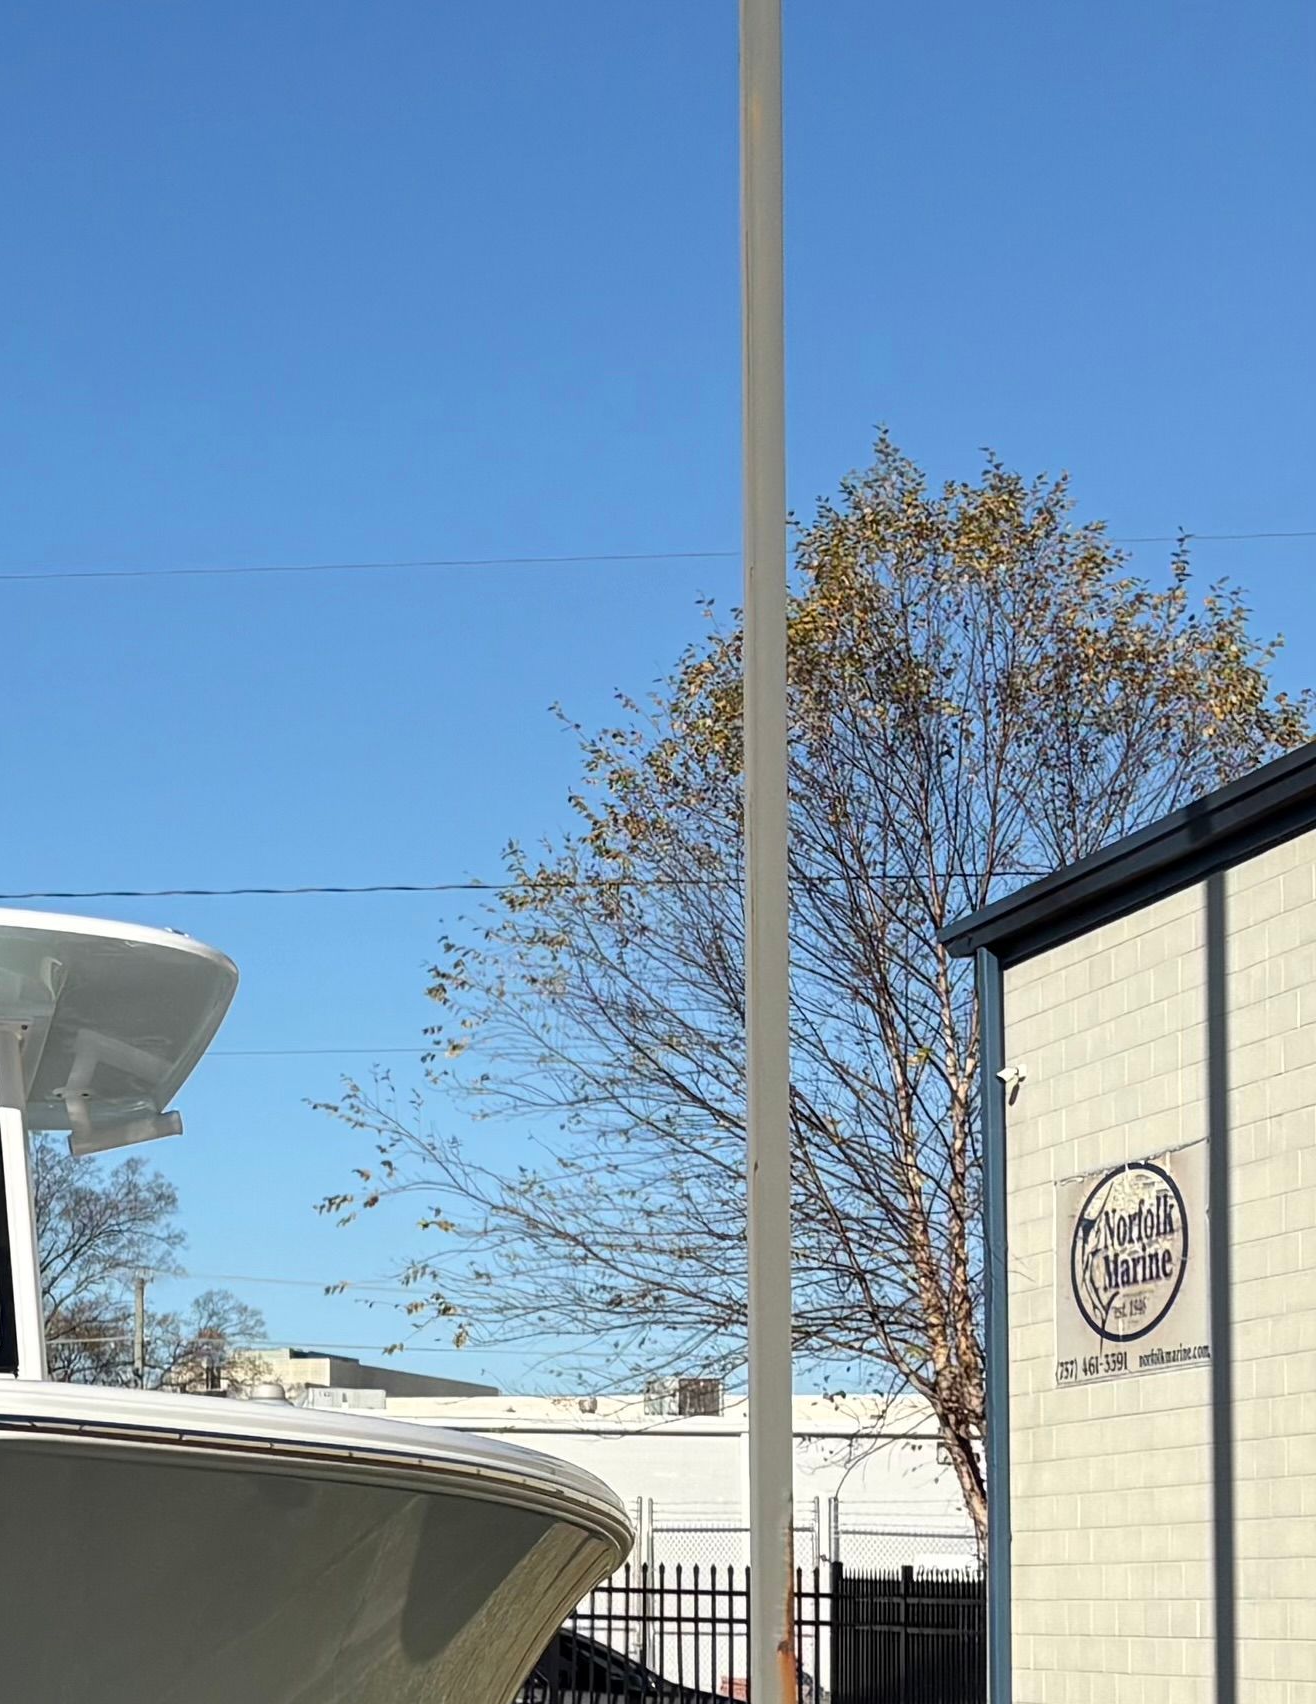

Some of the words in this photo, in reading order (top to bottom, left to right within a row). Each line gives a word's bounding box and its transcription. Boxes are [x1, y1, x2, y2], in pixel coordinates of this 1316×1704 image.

[1104, 1193, 1176, 1251] Norfolk
[1103, 1243, 1174, 1292] Marine
[1082, 1351, 1128, 1377] 461-3391
[1138, 1343, 1212, 1368] norfolkmarine.com
